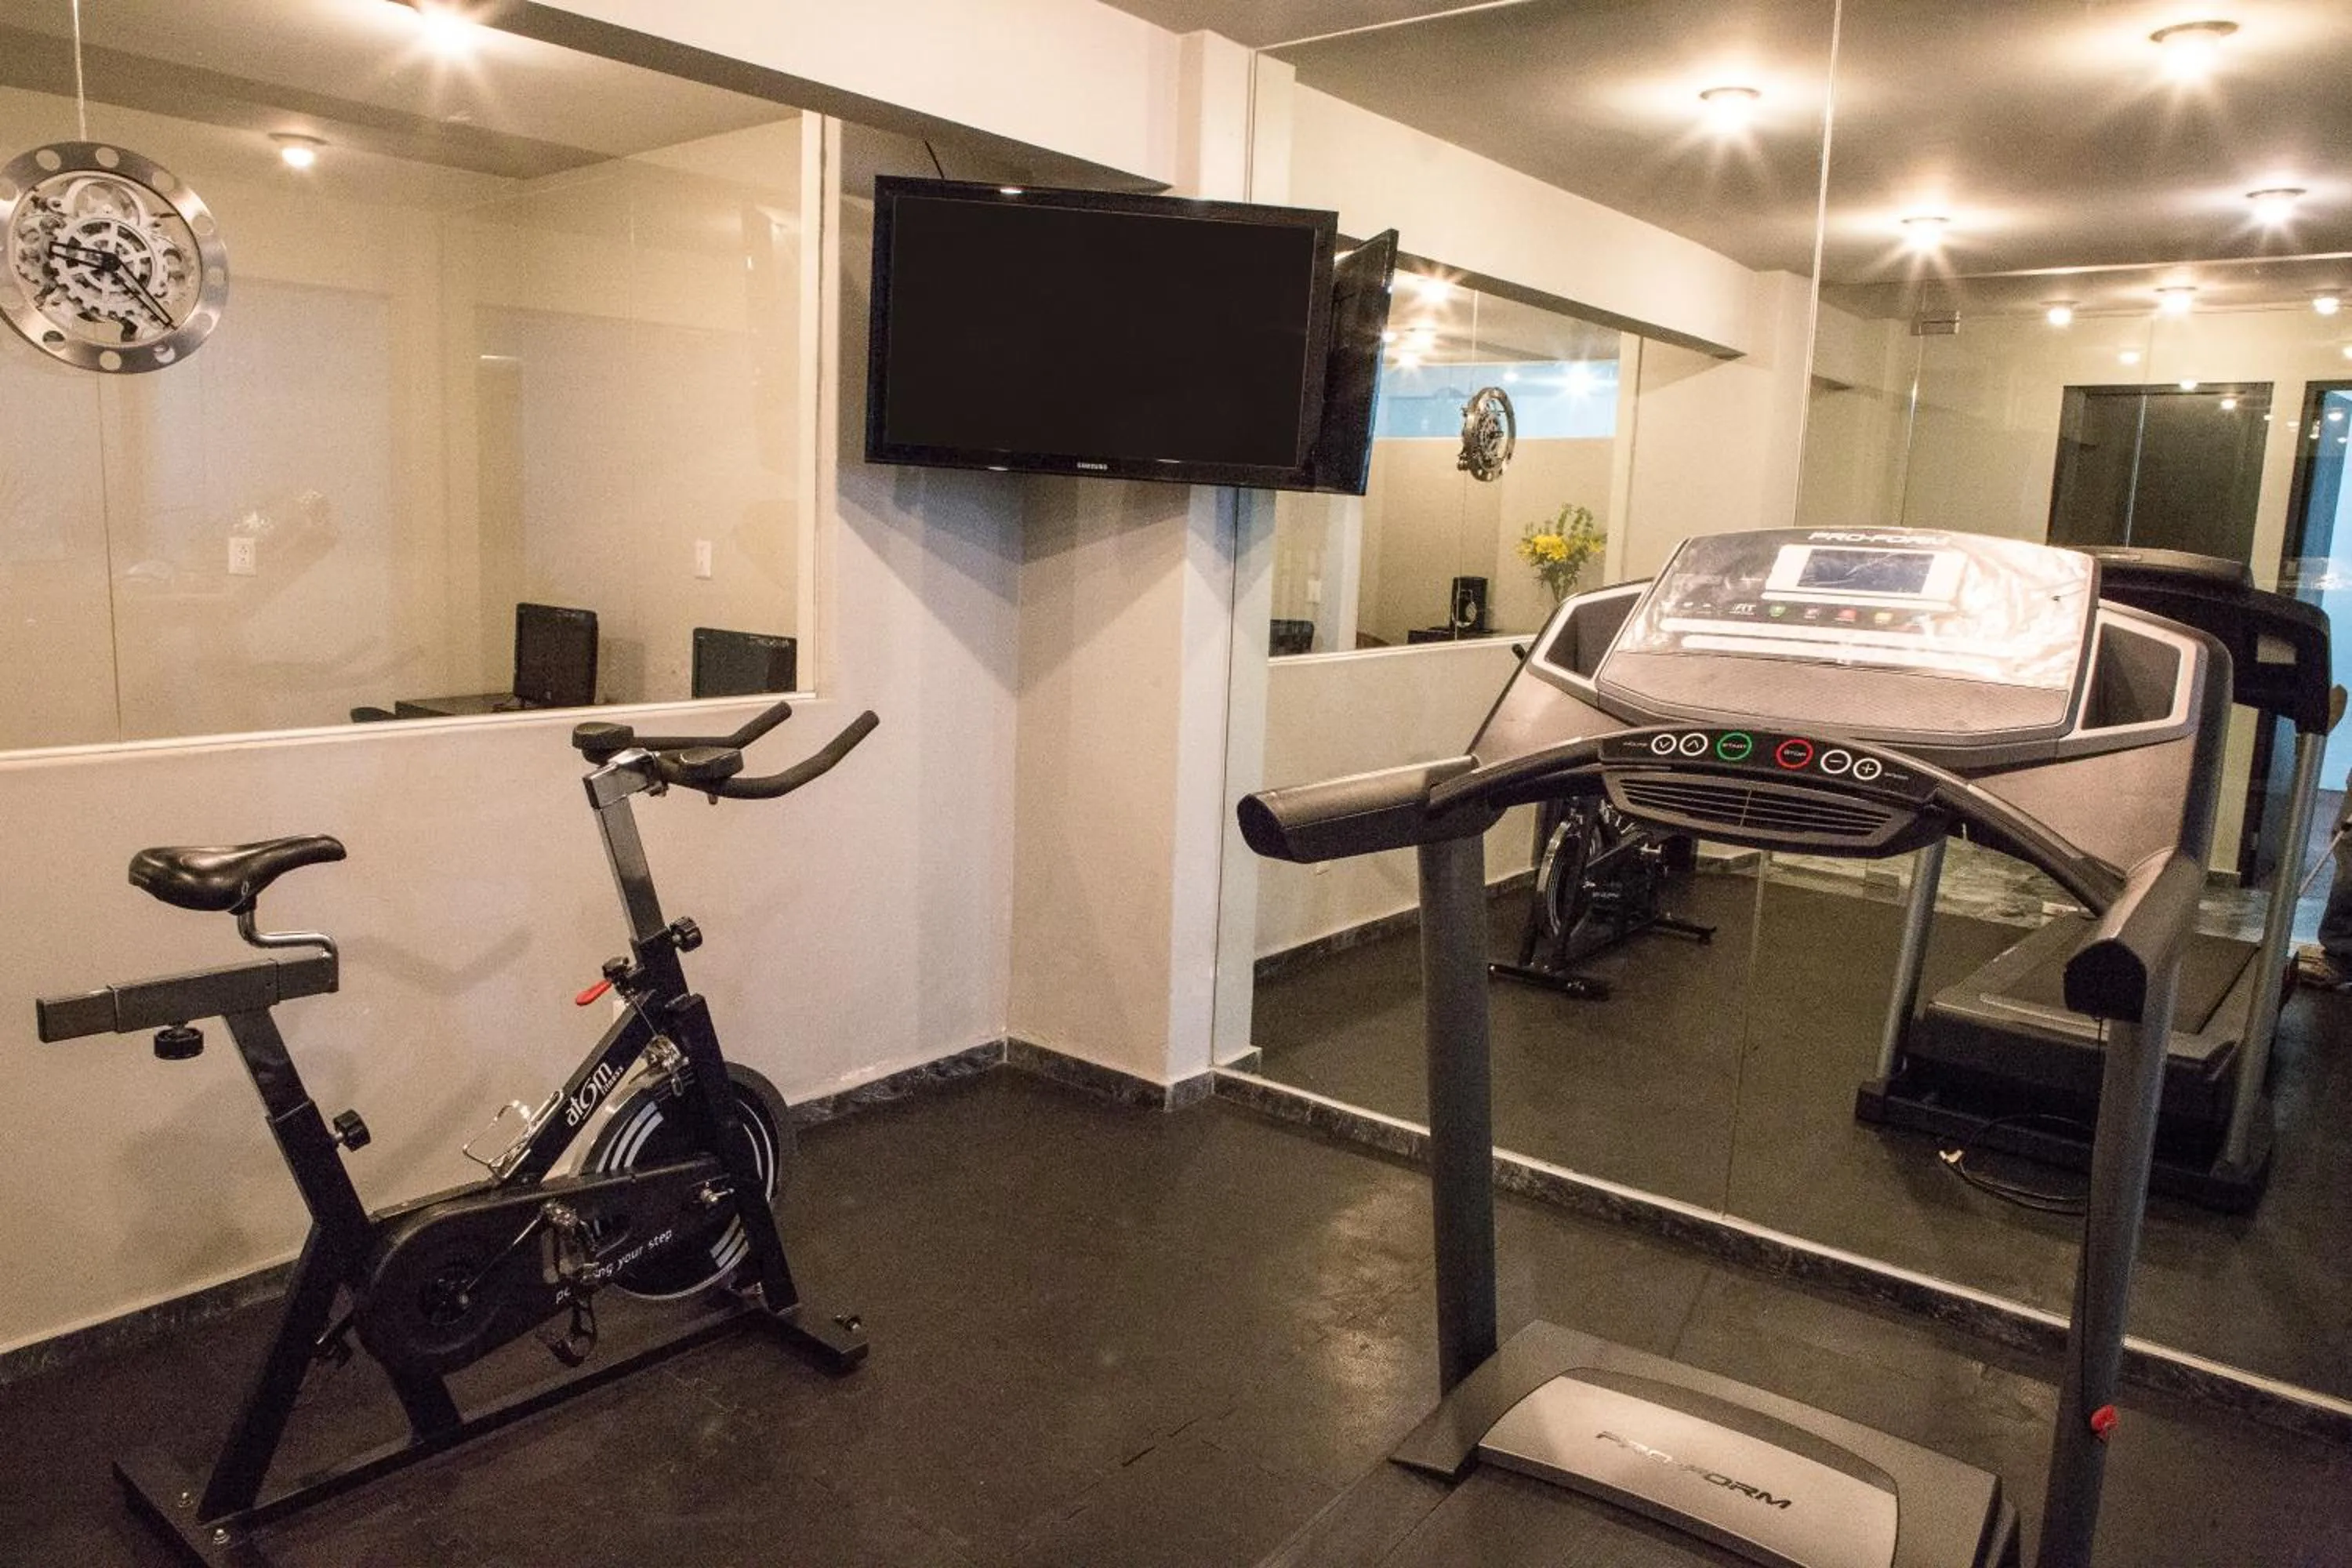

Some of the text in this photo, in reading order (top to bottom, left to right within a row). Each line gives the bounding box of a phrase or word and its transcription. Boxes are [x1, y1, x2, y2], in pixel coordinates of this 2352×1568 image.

[565, 1062, 612, 1127] atom
[617, 1246, 644, 1272] your
[648, 1229, 673, 1250] step
